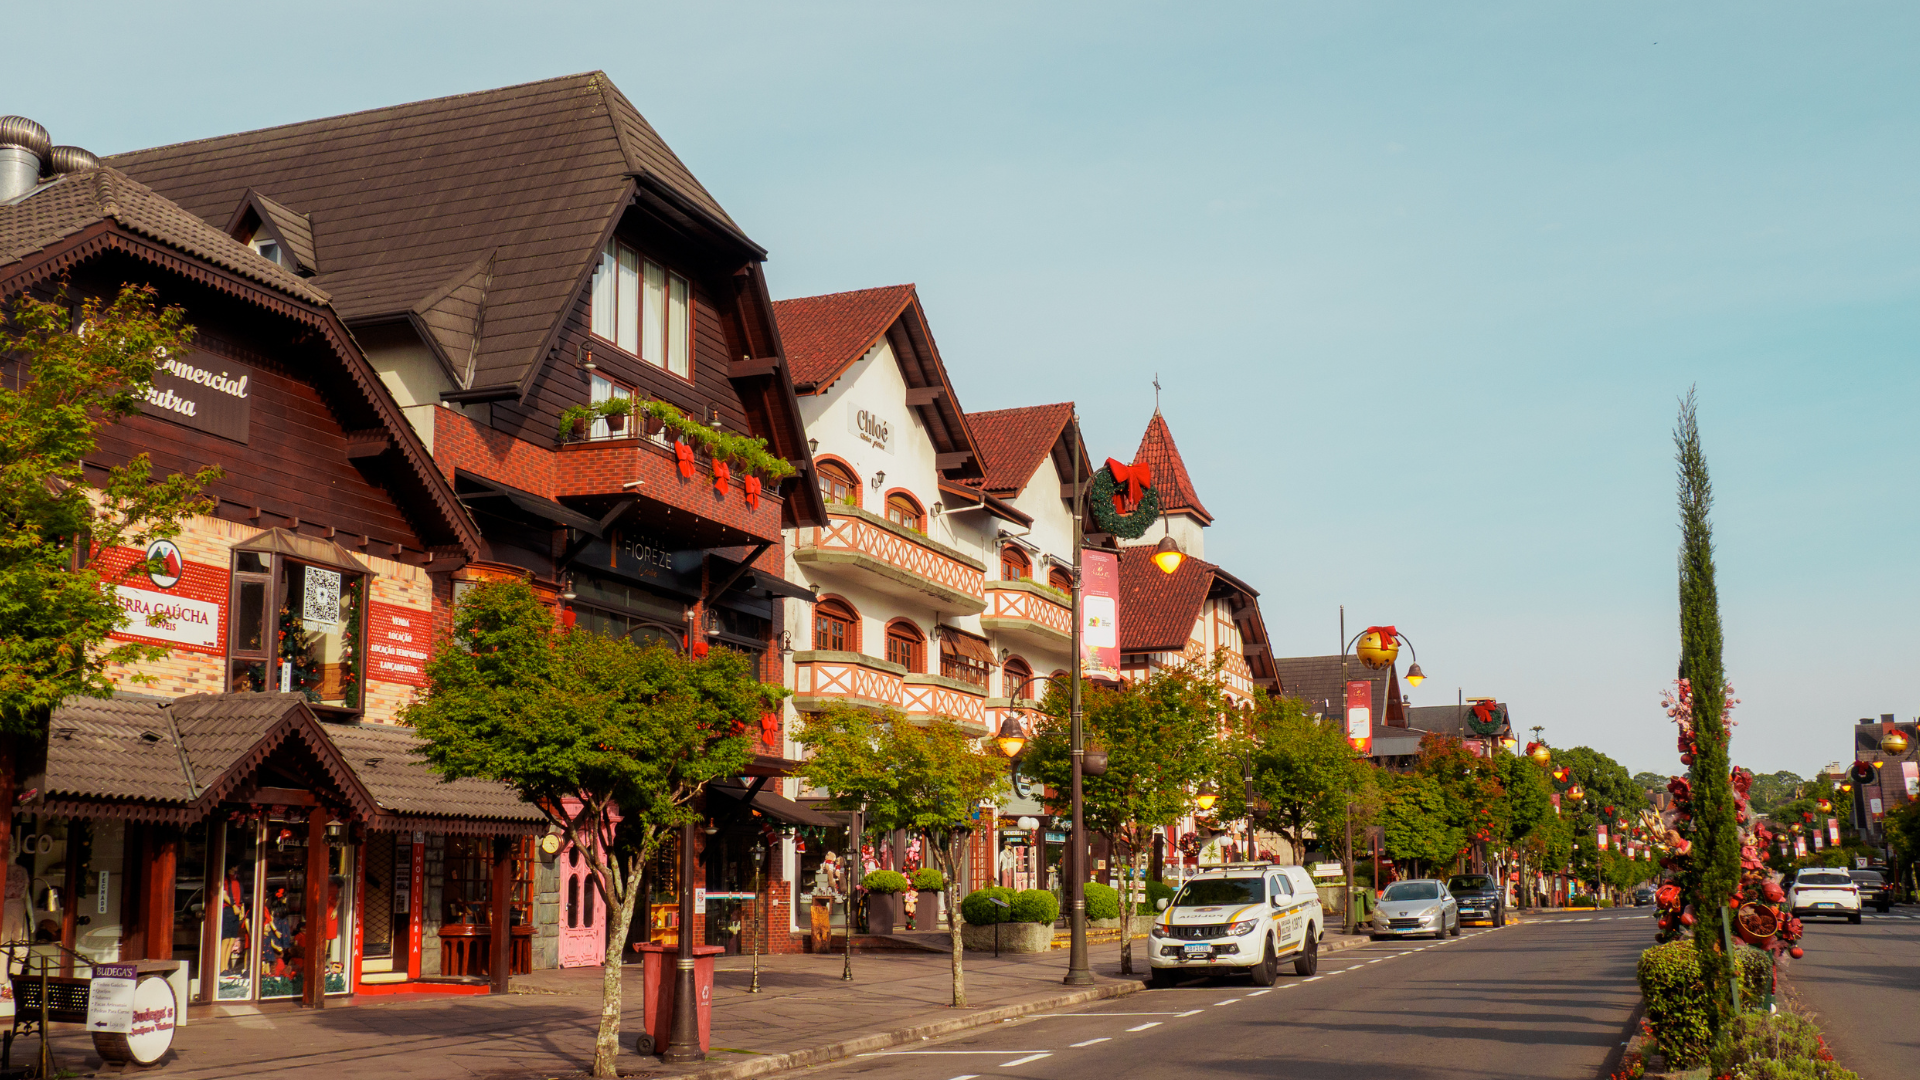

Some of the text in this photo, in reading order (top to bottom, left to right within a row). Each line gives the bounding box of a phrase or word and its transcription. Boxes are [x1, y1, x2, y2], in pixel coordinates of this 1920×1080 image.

[856, 409, 889, 443] Chloé
[625, 540, 672, 570] FIOREZE
[116, 596, 209, 625] ERRA GAÚCHA
[391, 614, 410, 628] VENDA
[380, 660, 418, 674] LANÇAMENTOS
[99, 872, 107, 912] FECHADO
